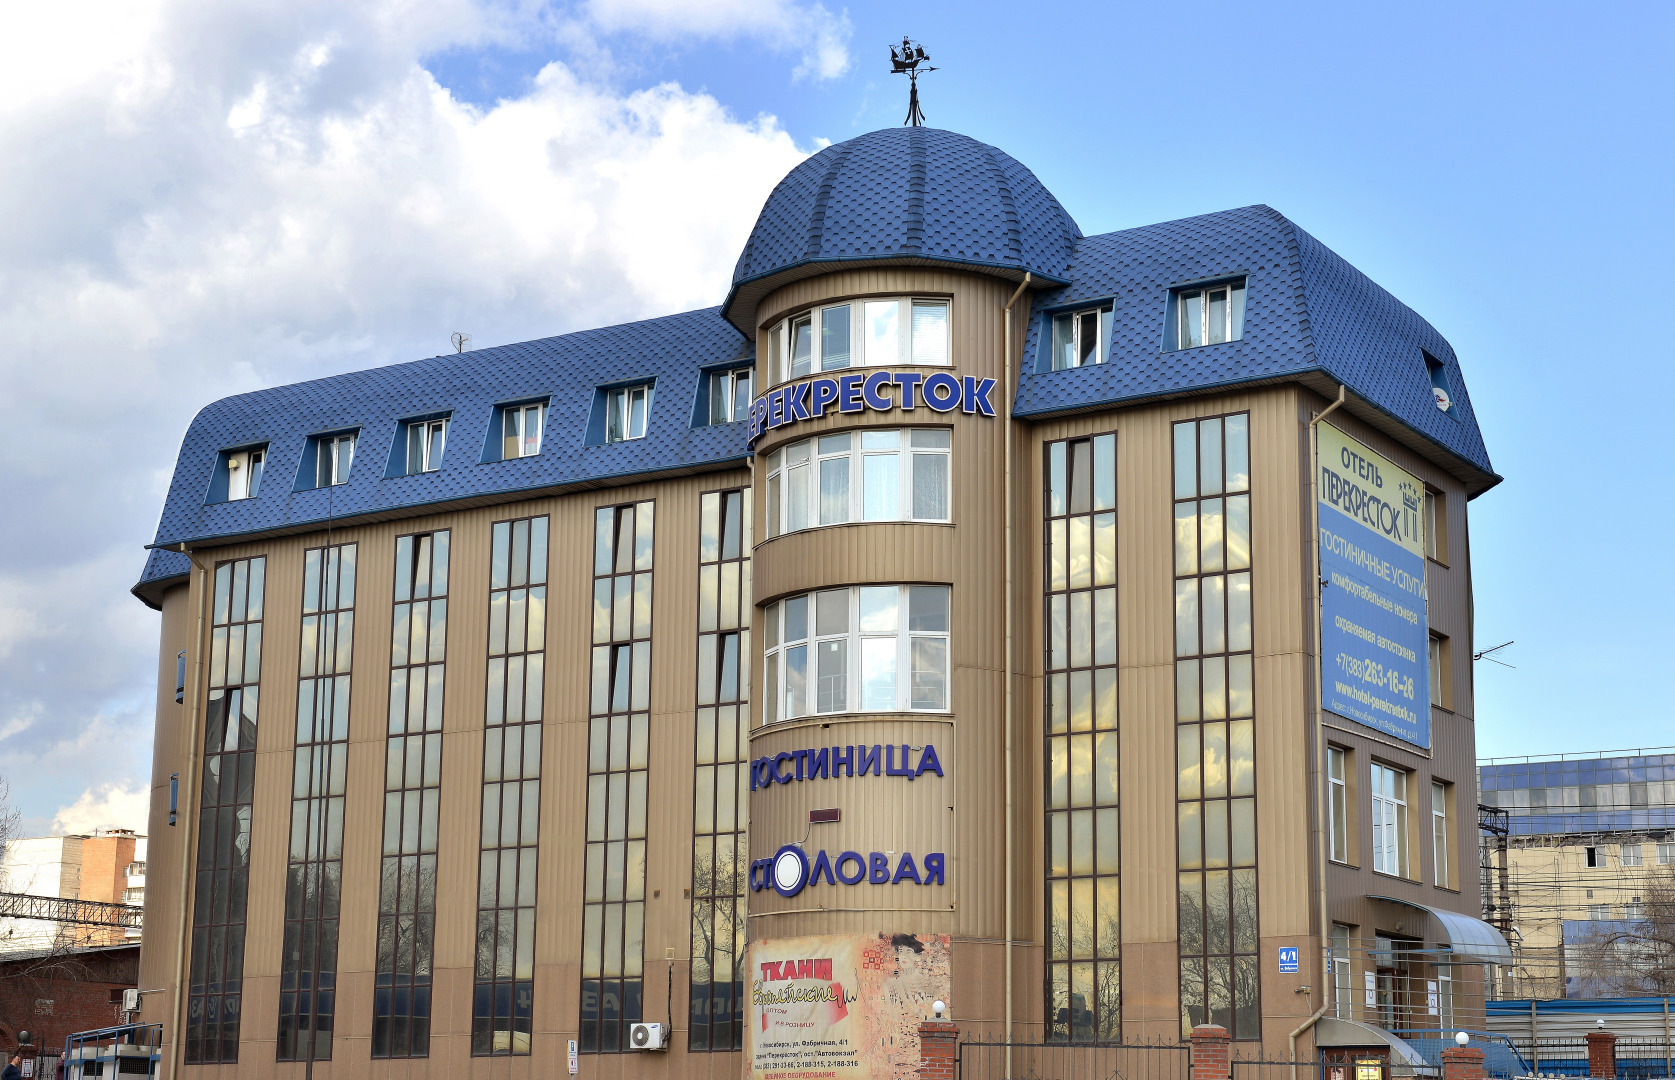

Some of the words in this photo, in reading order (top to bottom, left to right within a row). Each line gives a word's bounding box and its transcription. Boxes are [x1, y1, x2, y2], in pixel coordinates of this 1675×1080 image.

[746, 371, 998, 445] ЕРЕКРЕСТОК
[1341, 446, 1383, 489] ОТЕЛЬ
[1322, 466, 1402, 542] ПЕРЕКРЕСТОК
[1320, 527, 1391, 582] ГОСТИНИЧНЫЕ
[1391, 565, 1426, 600] УСЛУГИ
[1331, 571, 1394, 612] комфортабельные
[1394, 603, 1418, 625] номера
[1335, 615, 1376, 645] охраняемая
[1377, 635, 1416, 663] автостоянка
[1335, 680, 1417, 725] www.hotel-perekrestok.ru
[750, 744, 944, 791] ГОСТИНИЦА
[750, 845, 945, 897] СТОЛОВАЯ
[761, 958, 833, 982] ТКАНИ
[1280, 951, 1297, 961] 4/1
[801, 1039, 838, 1047] Фабричная,
[787, 1071, 836, 1079] ОБОРУДОВАНИЕ
